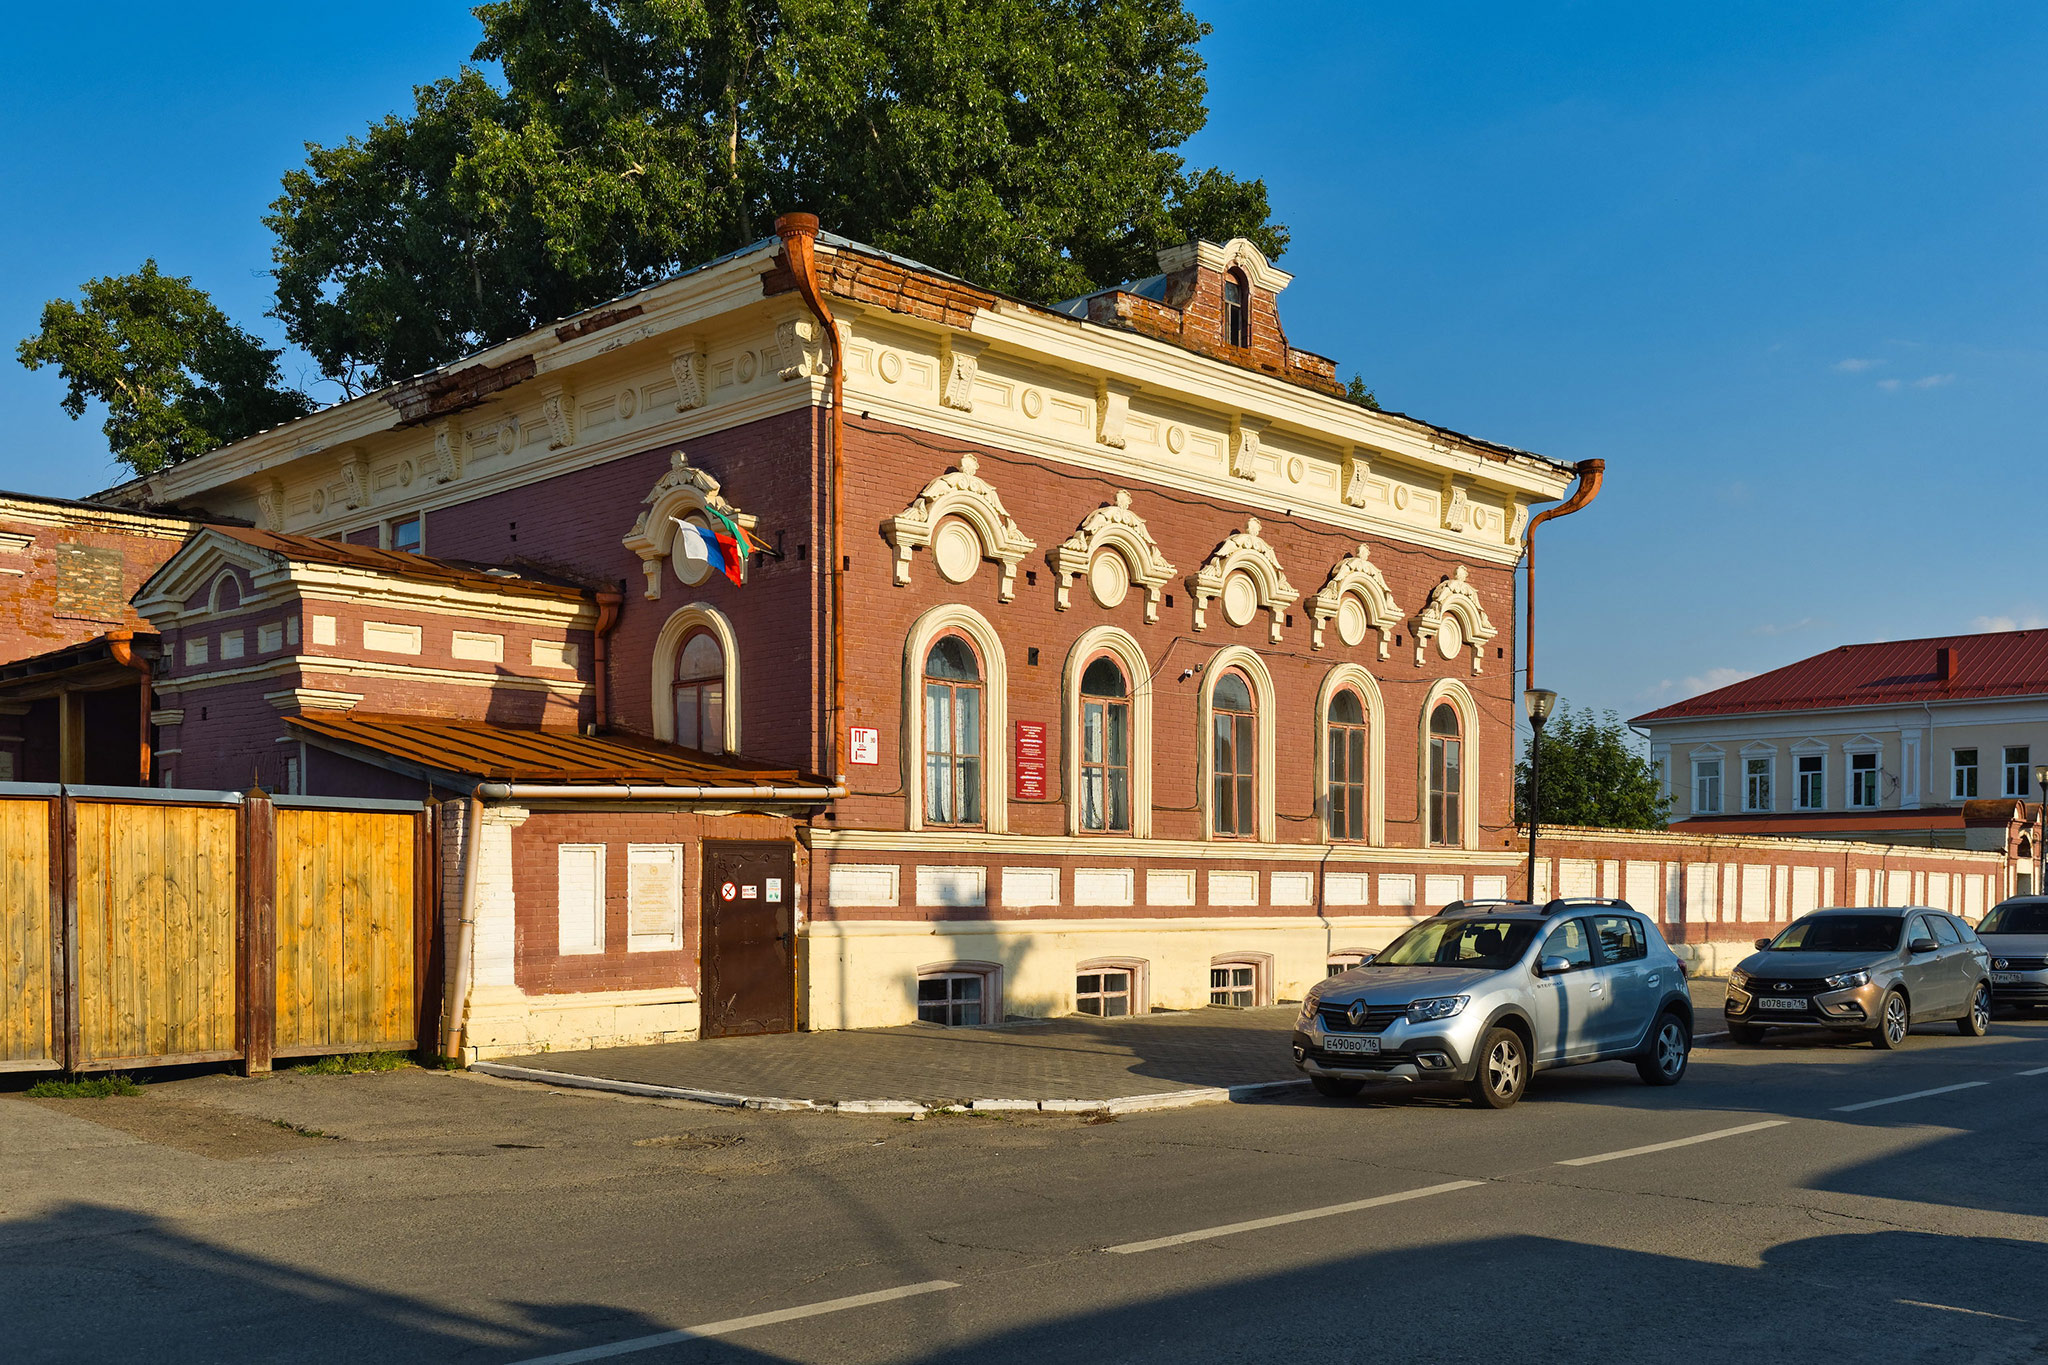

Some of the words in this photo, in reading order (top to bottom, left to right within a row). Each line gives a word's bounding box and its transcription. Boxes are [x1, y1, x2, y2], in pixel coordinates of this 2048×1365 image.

[855, 730, 868, 743] ПГ
[1326, 1038, 1361, 1051] Е490ВО
[1362, 1039, 1377, 1048] 716
